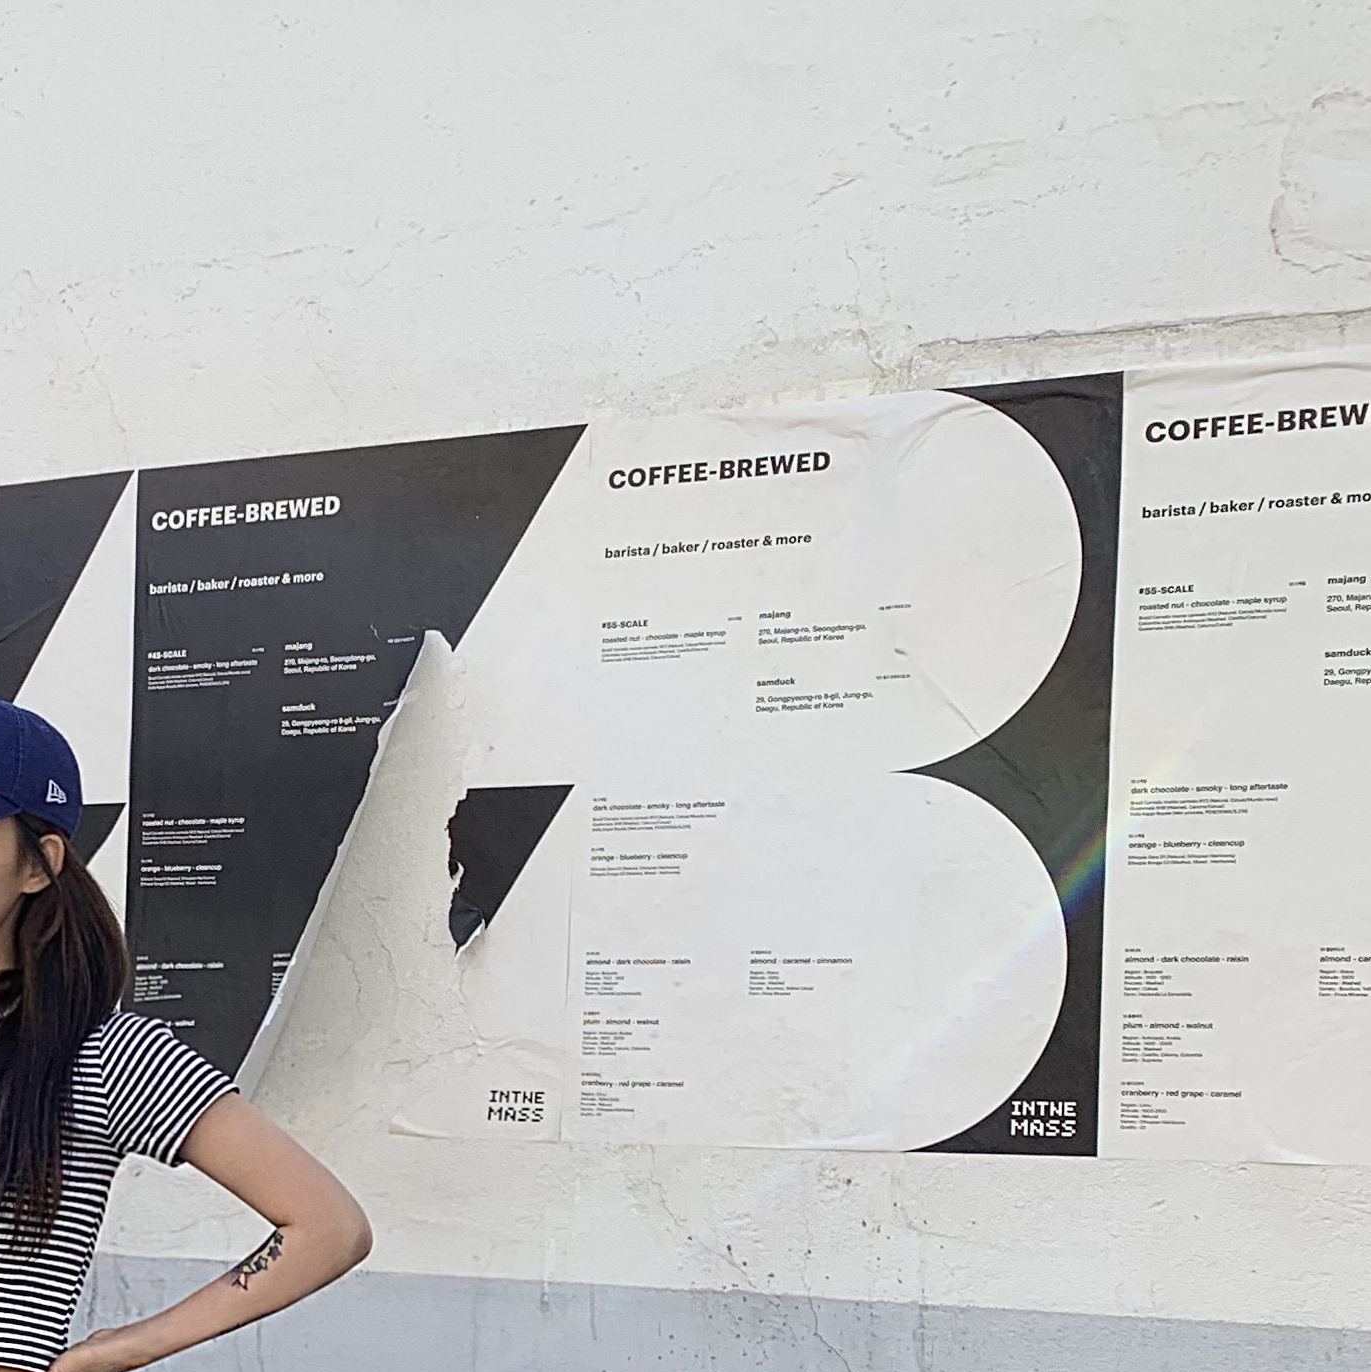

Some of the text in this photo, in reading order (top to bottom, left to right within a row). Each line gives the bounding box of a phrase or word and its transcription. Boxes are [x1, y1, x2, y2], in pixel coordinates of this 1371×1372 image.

[1145, 403, 1370, 443] COFFEE-BREW
[608, 451, 831, 489] COFFEE-BREWED
[1142, 504, 1196, 519] barista
[1209, 499, 1254, 514] baker
[1268, 494, 1327, 509] roaster
[1330, 492, 1342, 505] &
[151, 495, 341, 531] COFFEE-BREWED
[605, 545, 650, 559] barista
[662, 541, 700, 555] baker
[711, 537, 760, 551] roaster
[762, 535, 773, 547] &
[775, 533, 812, 546] more
[149, 581, 188, 595] barista
[197, 577, 229, 591] baker
[238, 574, 280, 588] roaster
[281, 572, 291, 585] &
[292, 571, 324, 584] more
[1327, 575, 1367, 585] majang
[1139, 584, 1194, 595] #55-SCALE
[1139, 596, 1288, 611] roasted nut chocolate maple syrup
[1326, 595, 1344, 603] 270,
[759, 611, 791, 621] majang
[756, 677, 796, 687] samduck
[1131, 782, 1288, 794] dark chocolate smoky long aftertaste
[1128, 841, 1157, 849] orange
[1163, 840, 1201, 849] blueberry
[1181, 955, 1220, 963] chocolate
[1122, 1022, 1143, 1030] plum
[1121, 1089, 1159, 1098] cranberry
[488, 1106, 544, 1122] MASS
[1010, 1119, 1076, 1137] MASS
